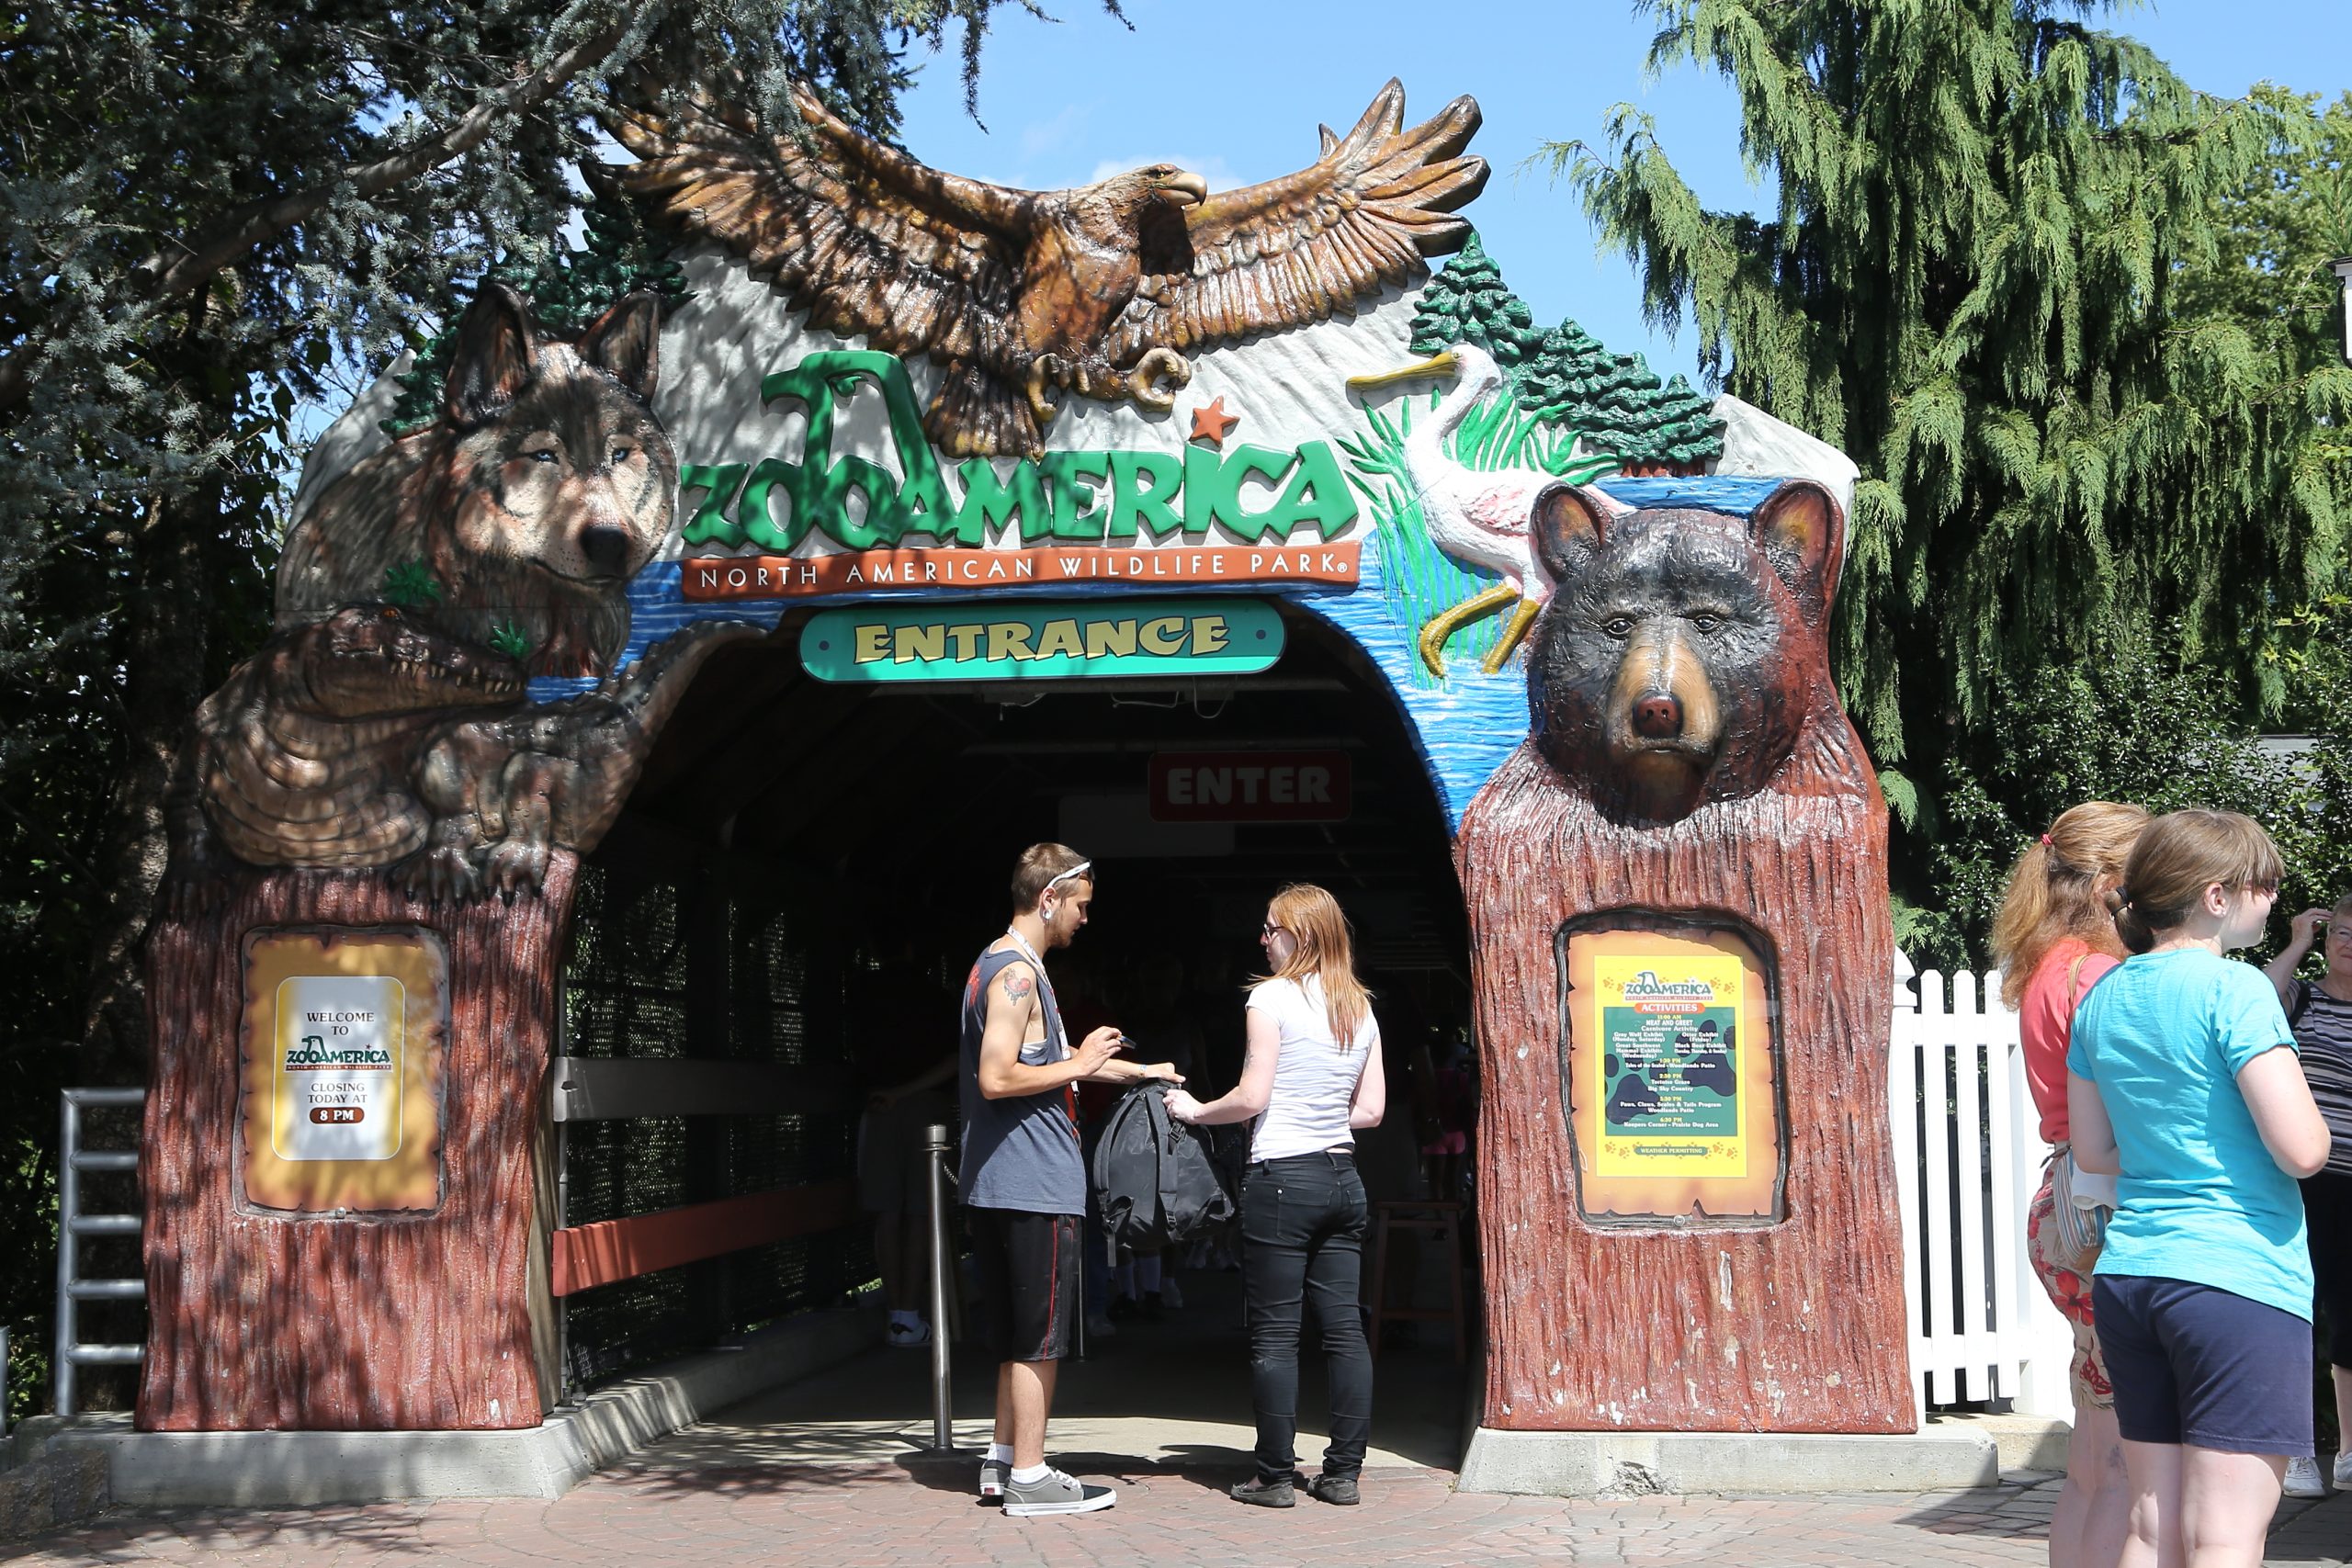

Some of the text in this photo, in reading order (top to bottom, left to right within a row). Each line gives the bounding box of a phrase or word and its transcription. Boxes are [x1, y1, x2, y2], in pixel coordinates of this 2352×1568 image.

[701, 565, 817, 588] NORTH
[846, 557, 1032, 583] AMERICAN
[1059, 554, 1224, 577] WILDLIFE
[853, 616, 1231, 665] ENTRANCE
[1168, 766, 1331, 805] ENTER
[1642, 1004, 1698, 1012] ACTIVITIES
[307, 1012, 374, 1021] WELCOME
[331, 1025, 349, 1035] TO
[311, 1083, 365, 1092] CLOSING
[308, 1094, 368, 1103] TODAY AT
[320, 1110, 355, 1121] 8 PM
